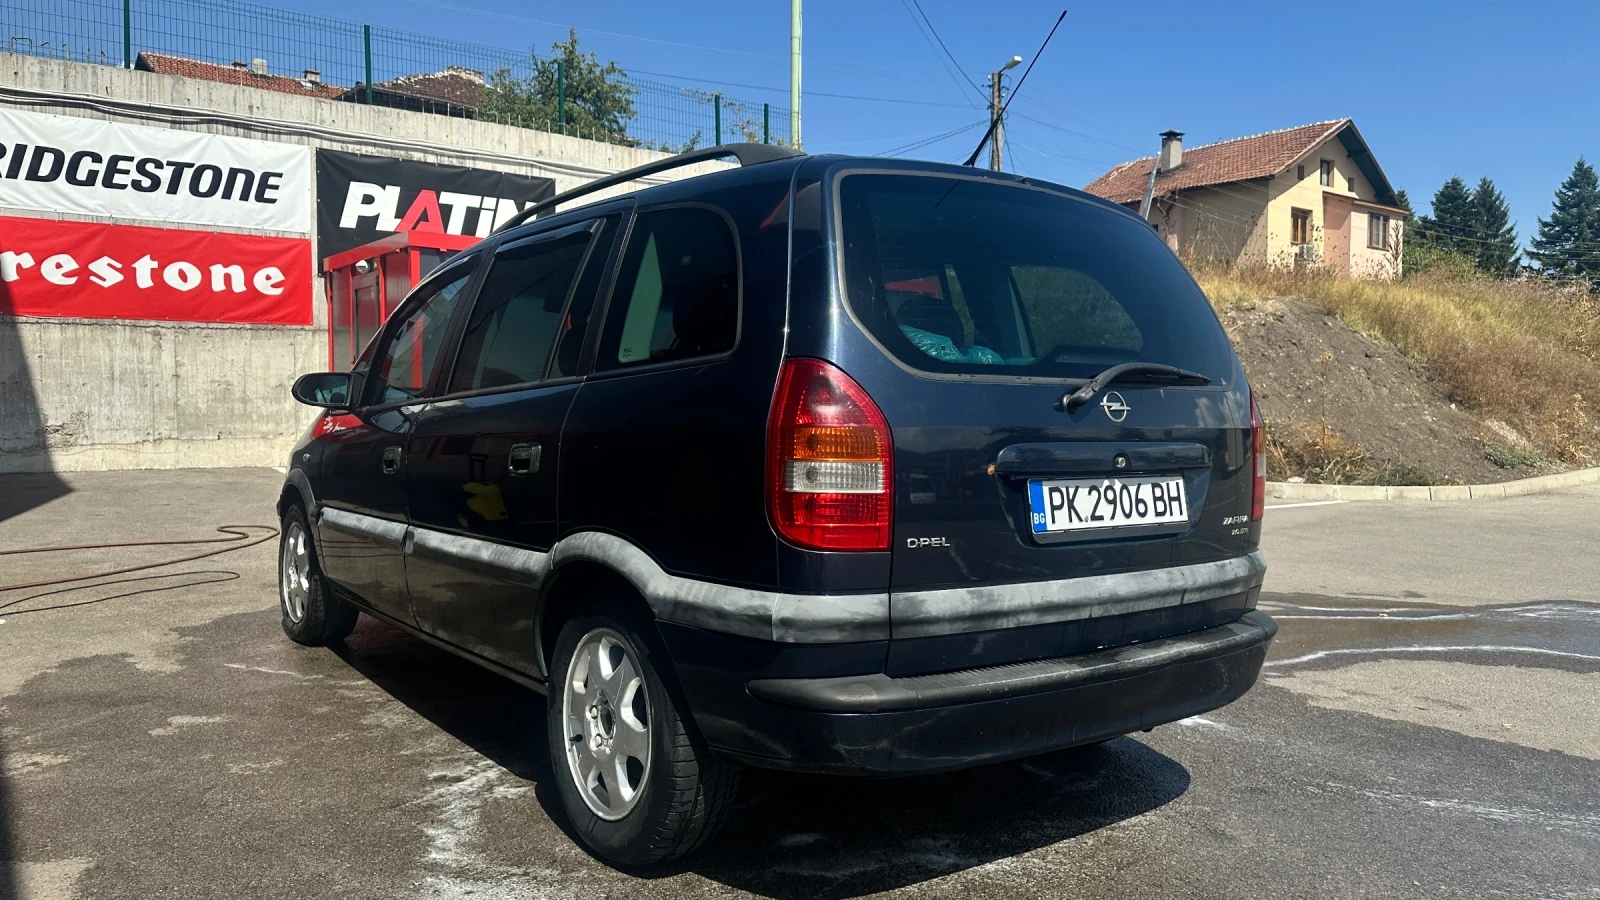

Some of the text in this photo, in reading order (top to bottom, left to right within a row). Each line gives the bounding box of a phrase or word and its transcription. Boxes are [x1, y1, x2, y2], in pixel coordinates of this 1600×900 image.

[0, 142, 284, 204] IDGESTONE
[1087, 483, 1149, 521] 2906
[1151, 481, 1184, 517] BH
[1034, 513, 1046, 525] BG
[906, 536, 951, 549] OPEL
